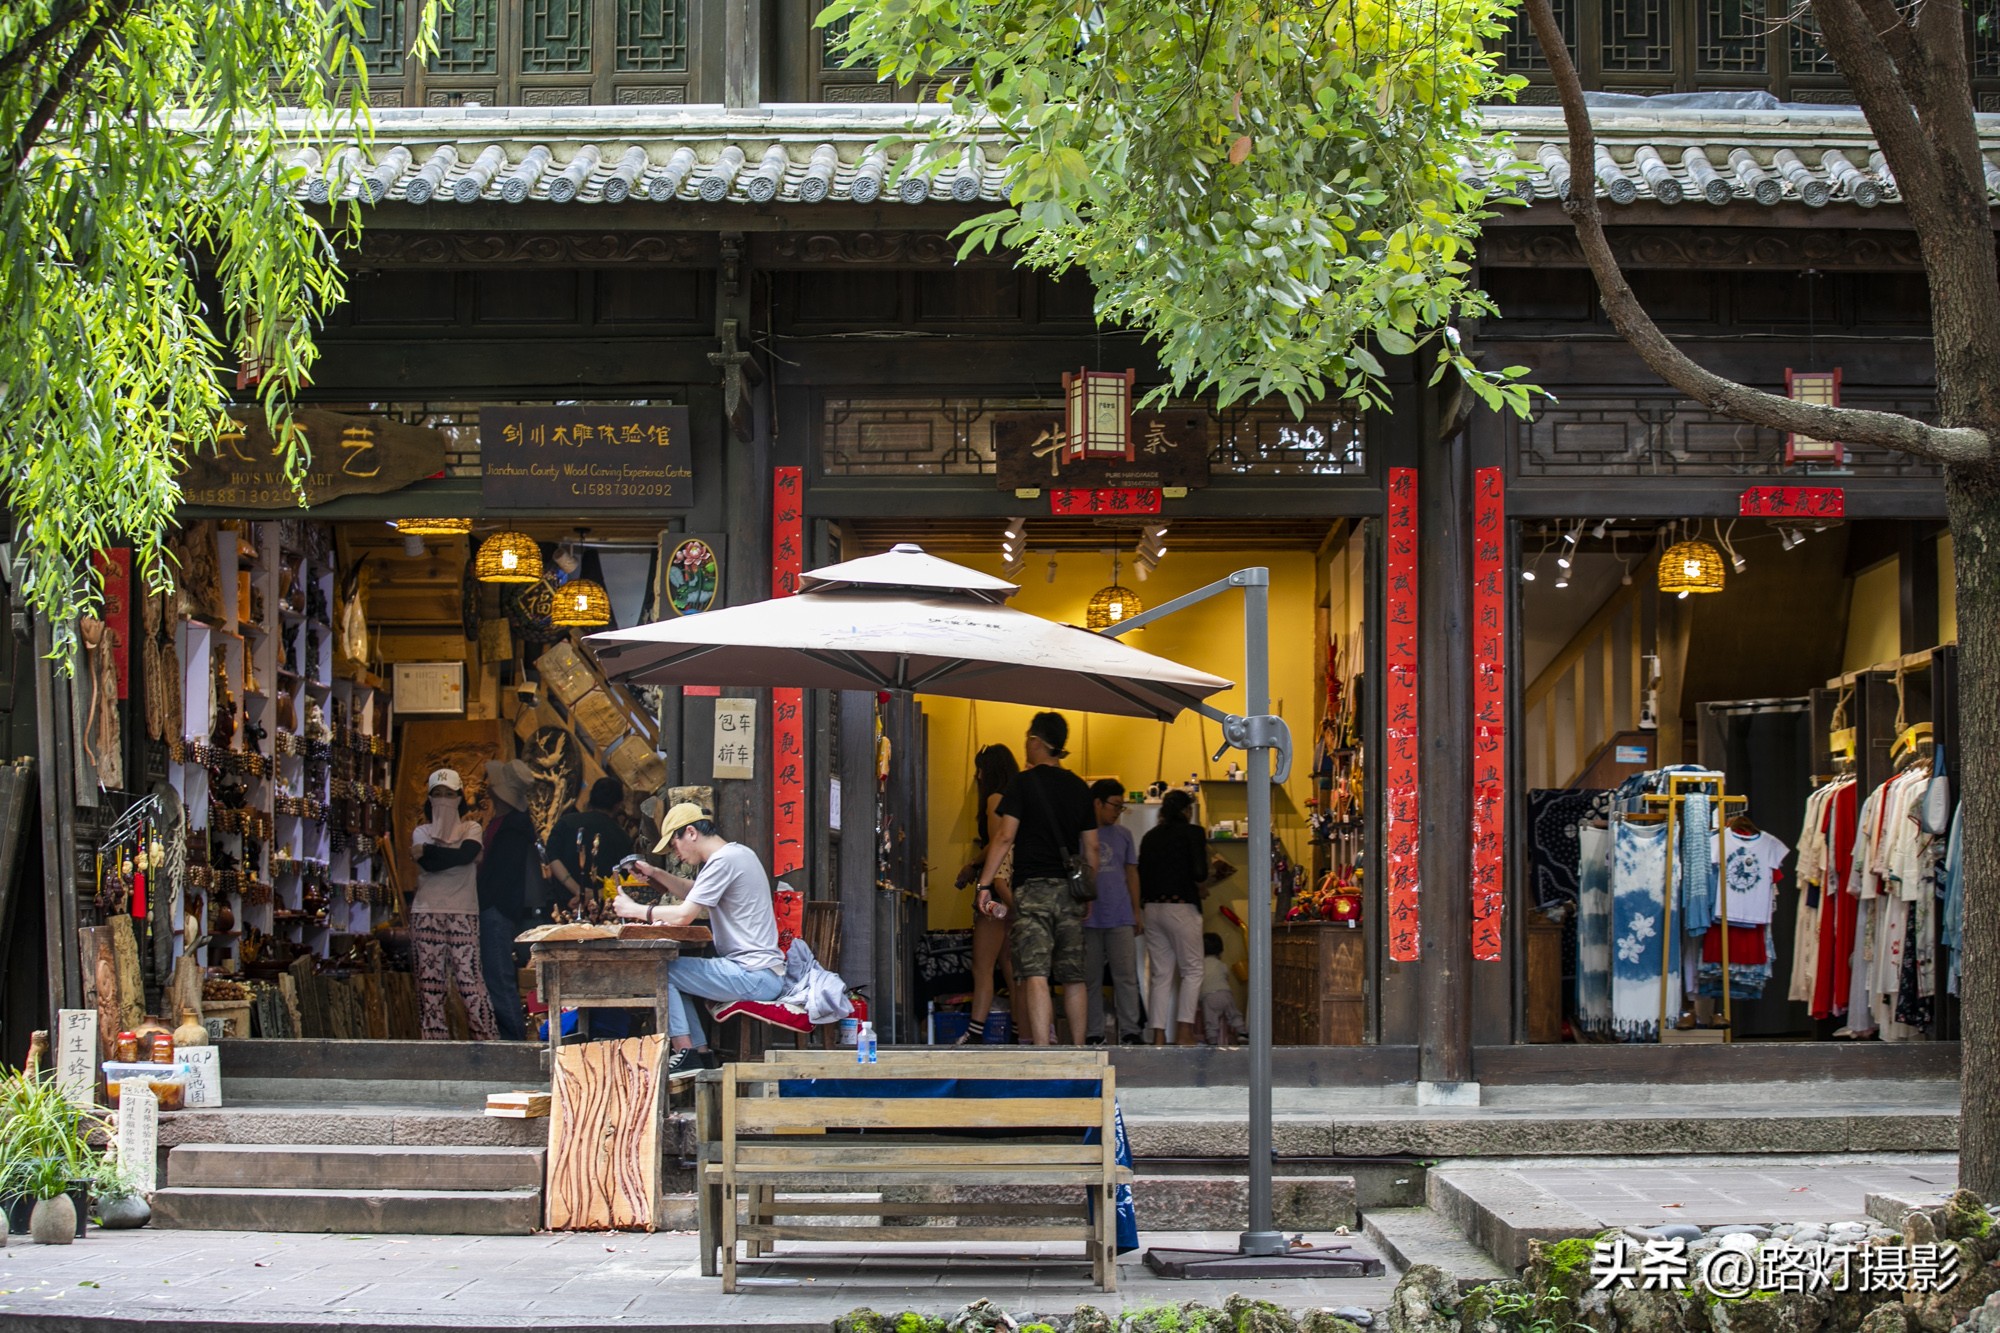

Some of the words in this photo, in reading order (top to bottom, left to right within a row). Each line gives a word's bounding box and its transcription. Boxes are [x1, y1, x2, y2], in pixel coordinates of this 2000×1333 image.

[502, 422, 671, 447] 剑川木雕体验馆
[231, 472, 260, 485] HO'S
[308, 473, 333, 486] ART
[530, 463, 559, 481] County
[563, 463, 588, 476] Wood
[590, 463, 622, 481] Carving
[623, 463, 664, 481] Experience
[665, 464, 692, 477] Centre
[718, 713, 752, 735] 包车
[717, 743, 749, 766] 拼车
